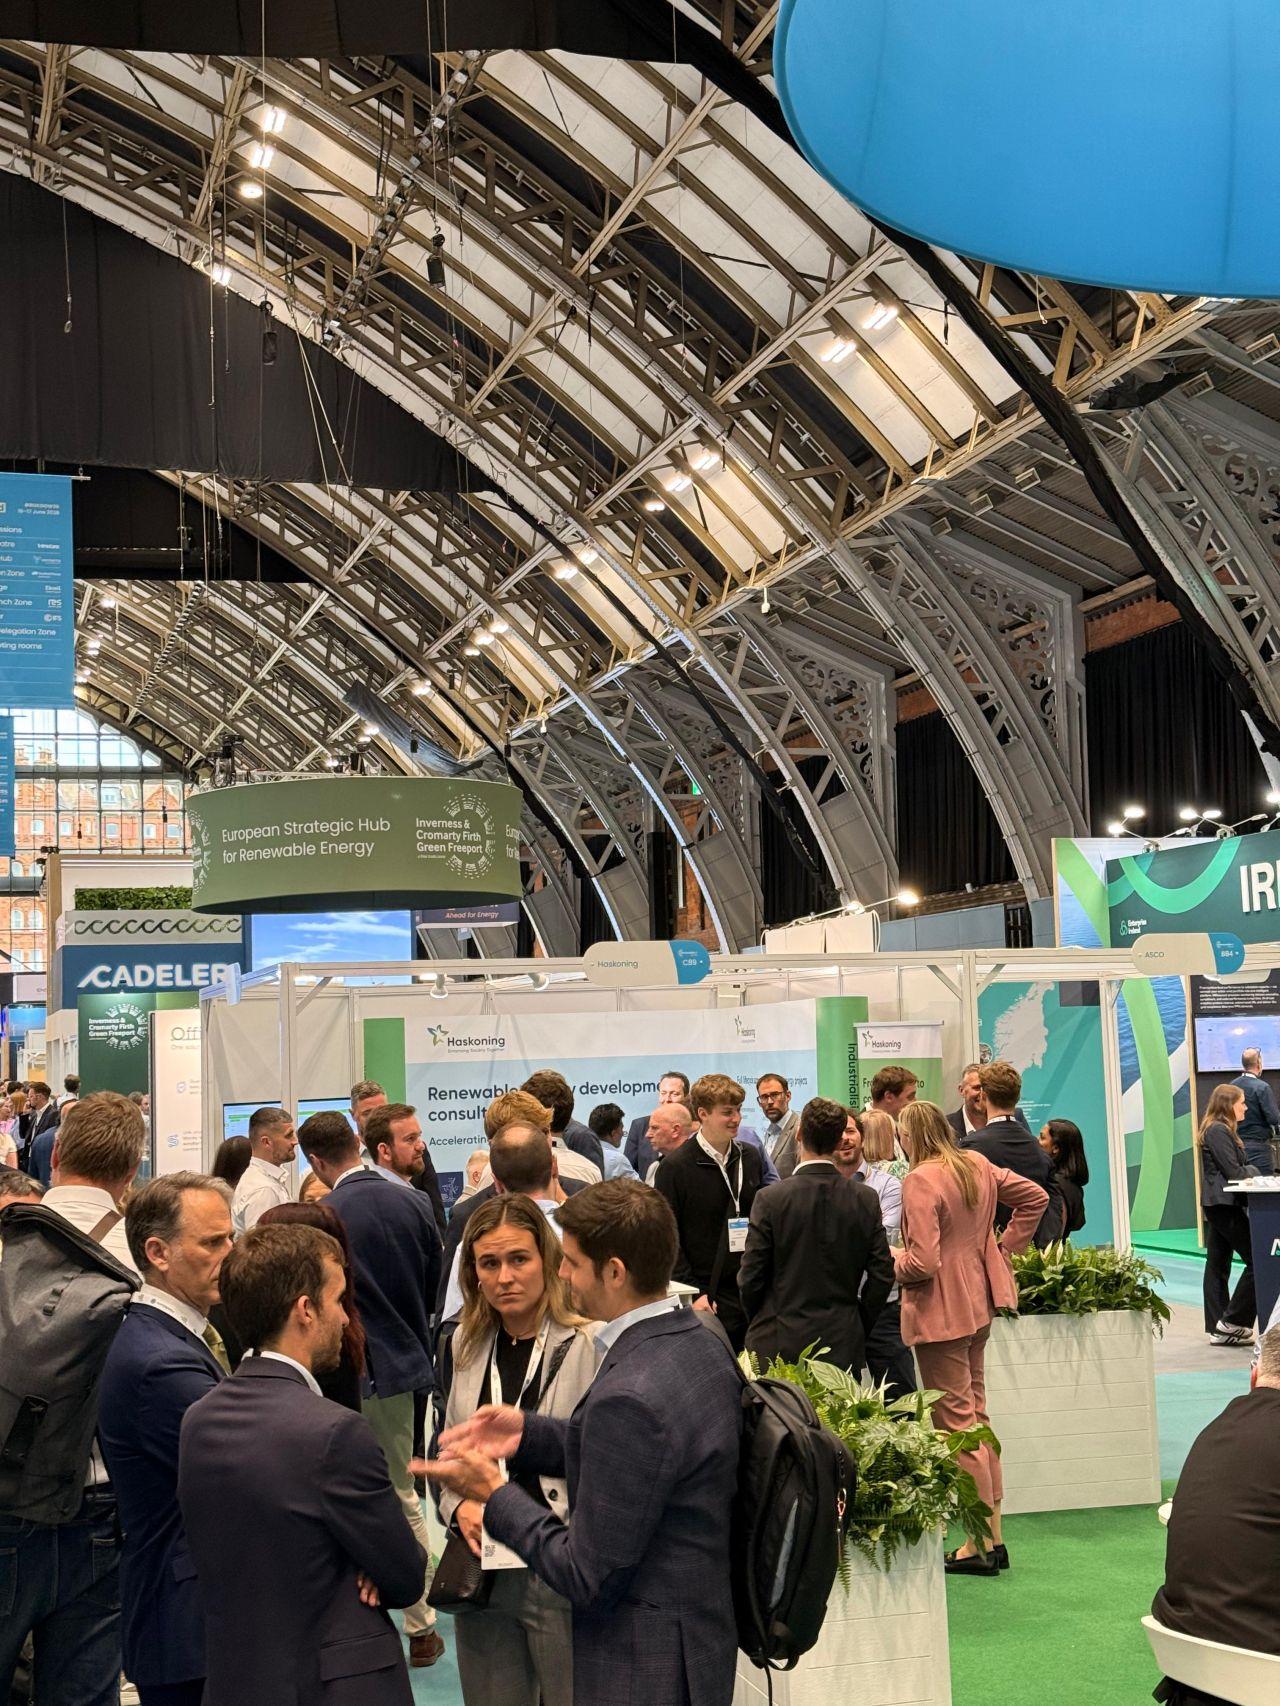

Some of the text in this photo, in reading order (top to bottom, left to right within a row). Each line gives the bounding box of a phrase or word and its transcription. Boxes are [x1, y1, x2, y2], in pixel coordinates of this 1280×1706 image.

[14, 598, 33, 606] Zone
[37, 628, 57, 636] Zone
[416, 817, 471, 829] Inverness &
[222, 817, 391, 843] European Strategic Hub
[416, 829, 482, 842] Cromarty Firth
[223, 841, 375, 865] for Renewable Energy
[416, 841, 483, 855] Green Freeport
[445, 911, 466, 919] Ahead
[477, 911, 499, 919] Energy
[597, 960, 638, 969] Haskoning
[77, 962, 229, 989] CADELER
[447, 1036, 506, 1049] Haskoning
[872, 1040, 902, 1050] Haskoning
[429, 1135, 487, 1147] Acceleratin
